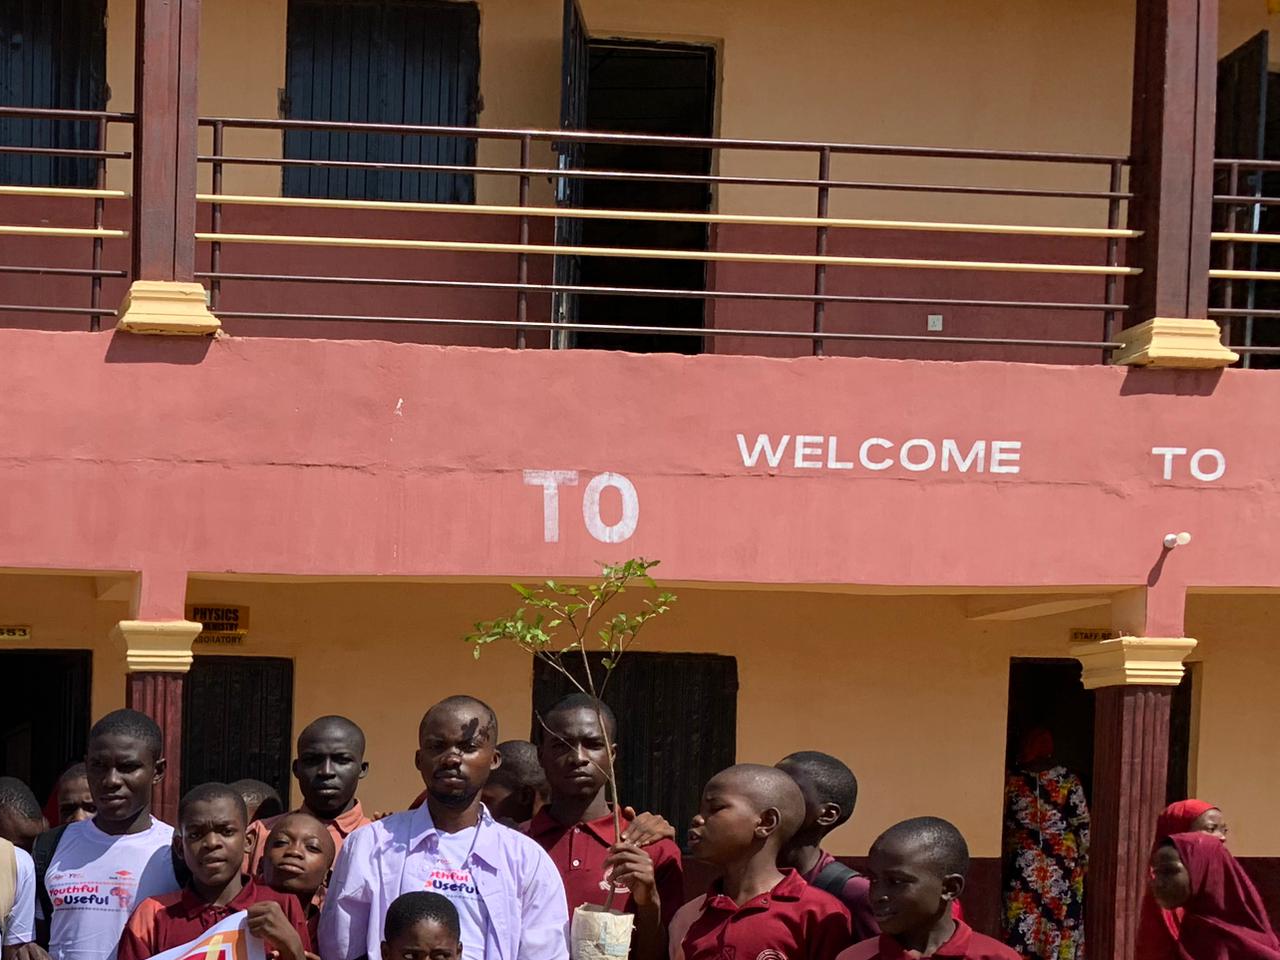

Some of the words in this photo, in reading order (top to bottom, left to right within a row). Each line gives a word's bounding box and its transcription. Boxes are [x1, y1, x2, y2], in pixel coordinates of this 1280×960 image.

[736, 433, 1022, 474] WELCOME
[1151, 447, 1227, 482] TO
[523, 469, 639, 544] TO
[193, 607, 239, 621] PHYSICS
[49, 885, 99, 896] Youthful
[63, 894, 109, 905] Useful
